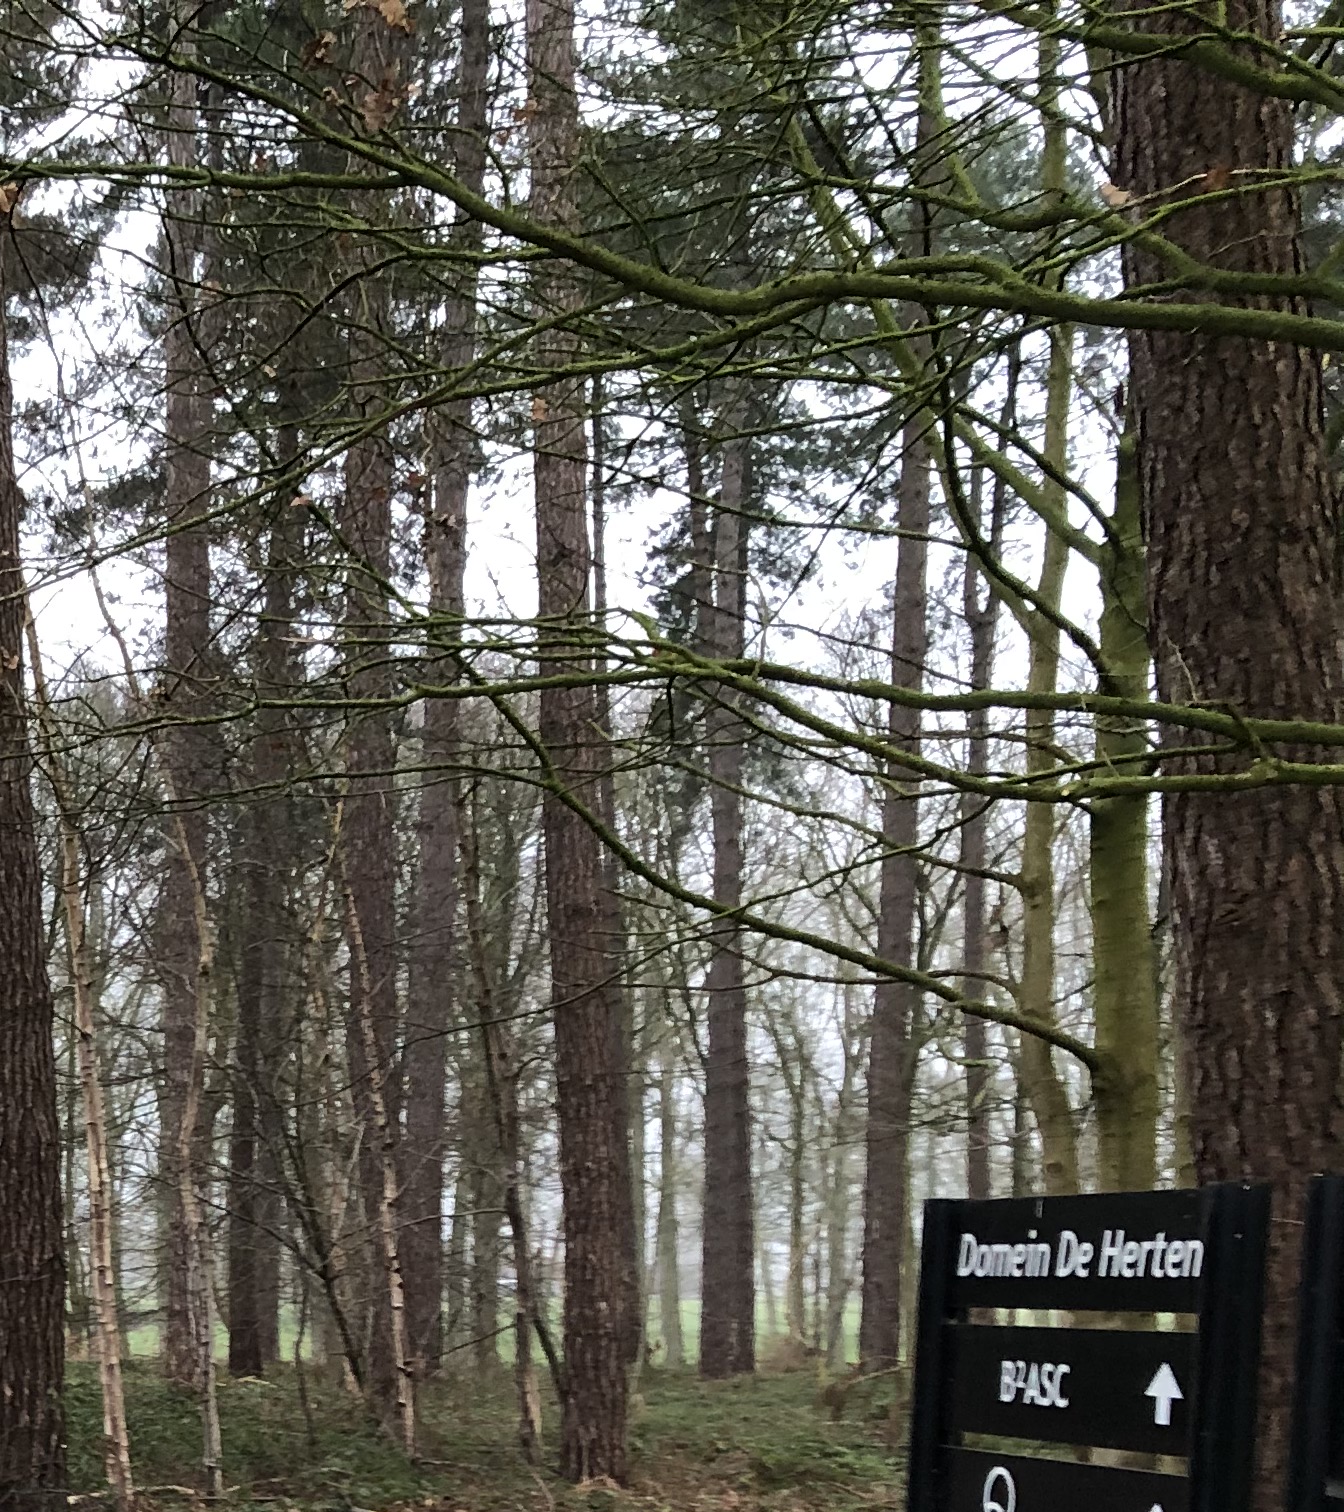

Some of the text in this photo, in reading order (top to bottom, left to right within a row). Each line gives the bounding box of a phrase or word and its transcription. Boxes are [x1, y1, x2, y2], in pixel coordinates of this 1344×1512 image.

[957, 1229, 1204, 1279] Domein De Herten
